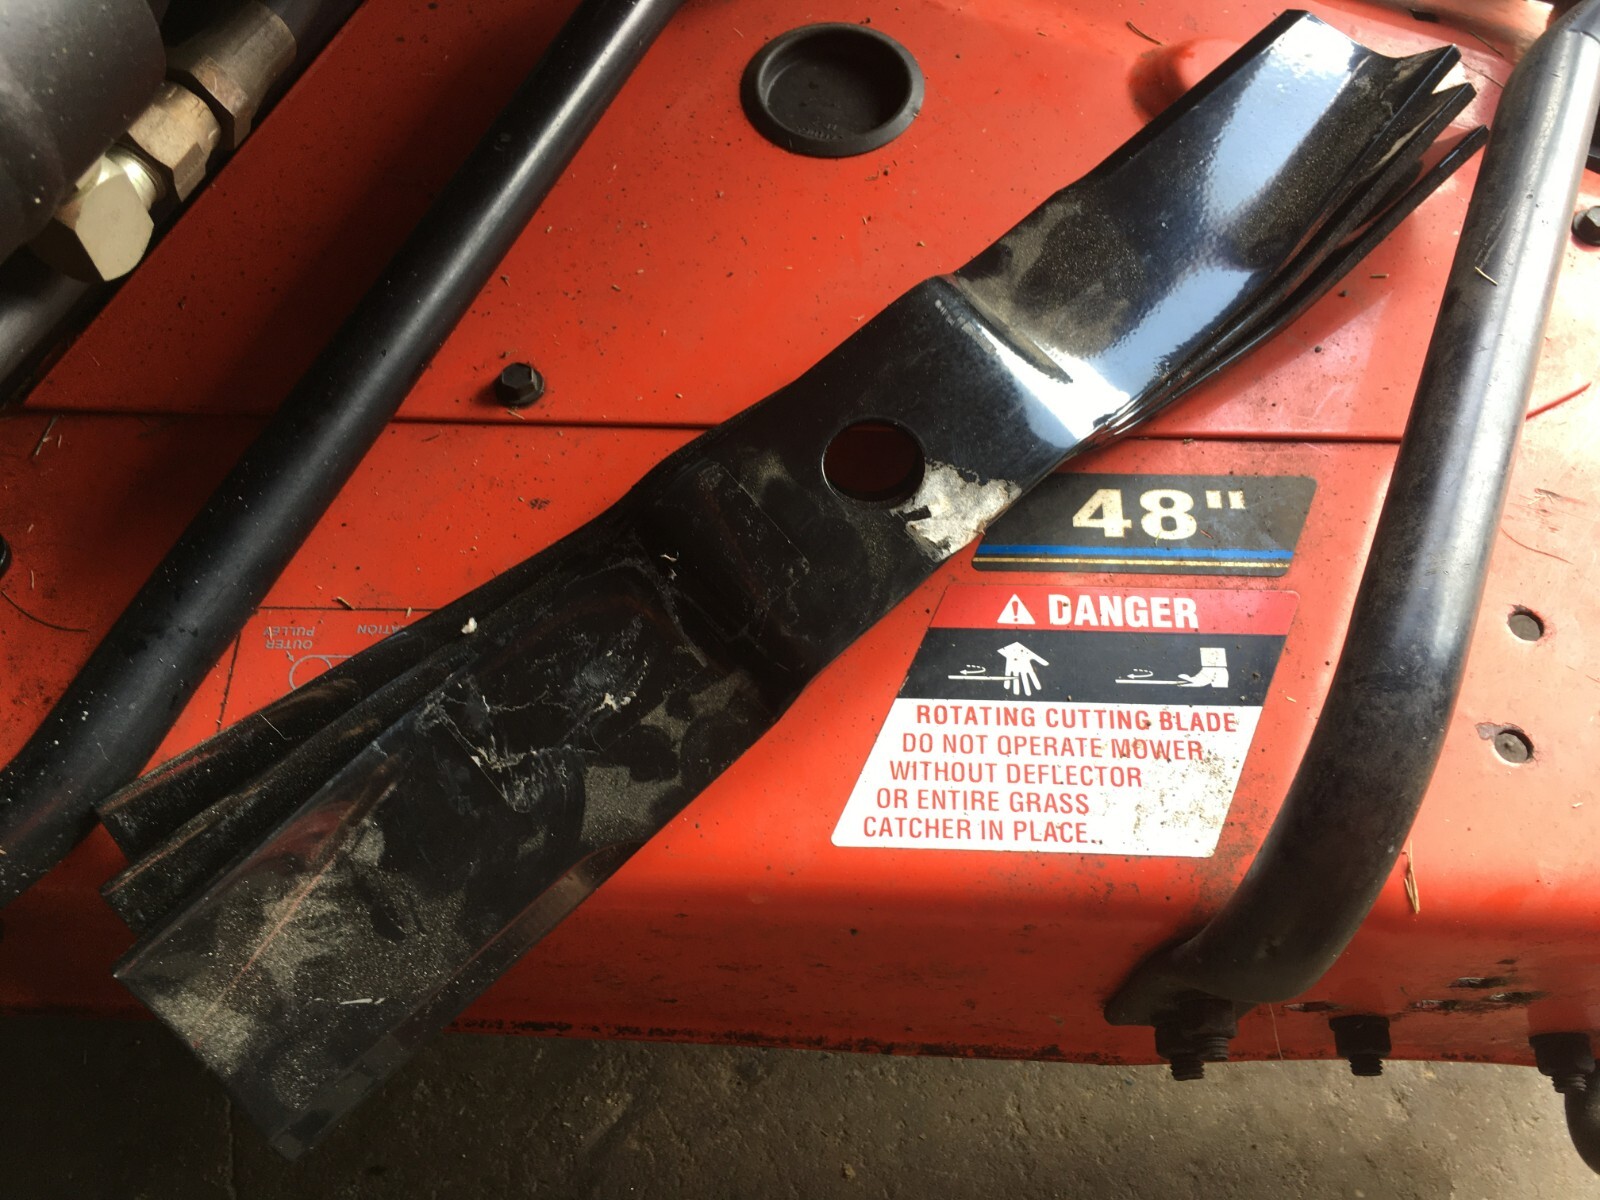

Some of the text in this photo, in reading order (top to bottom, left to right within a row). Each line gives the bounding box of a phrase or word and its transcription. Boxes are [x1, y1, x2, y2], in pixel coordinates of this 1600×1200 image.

[1072, 488, 1246, 540] 48"
[1048, 594, 1199, 629] DANGER
[357, 624, 407, 635] ATION
[265, 639, 313, 650] OUTER
[916, 704, 1237, 733] ROTATING CUTTING BLADE
[902, 733, 1204, 762] DO NOT OPERATE MOWER
[889, 760, 1143, 788] WITHOUT DEFLECTOR
[876, 788, 1090, 815] OR ENTIRE GRASS
[863, 816, 971, 840] CATCHER
[981, 819, 1004, 841] IN
